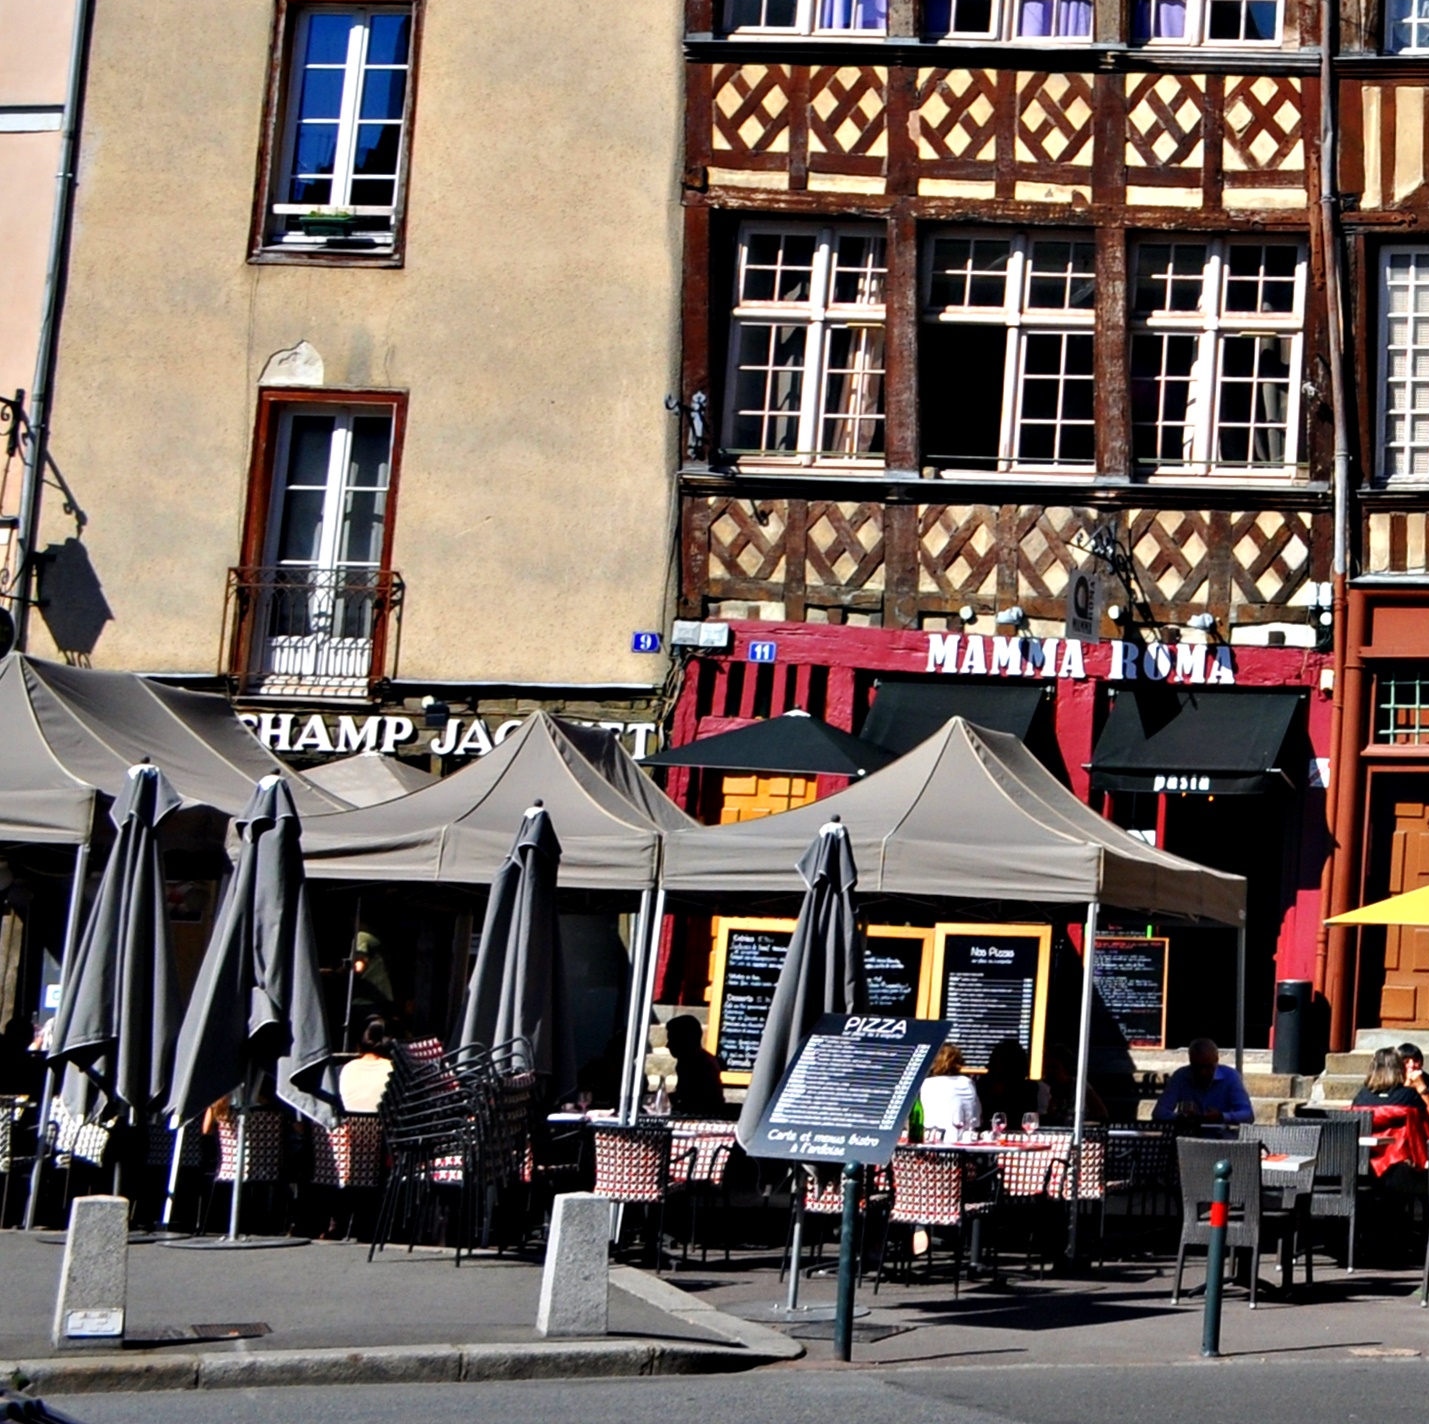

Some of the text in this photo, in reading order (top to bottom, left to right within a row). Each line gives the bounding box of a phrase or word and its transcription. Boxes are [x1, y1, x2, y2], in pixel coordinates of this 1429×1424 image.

[640, 634, 652, 650] 9
[754, 644, 770, 660] 11
[926, 633, 1236, 685] MAMMA ROMA
[1153, 774, 1210, 792] pasta
[844, 1016, 907, 1035] PIZZA
[768, 1128, 879, 1146] Carte et menus bistro
